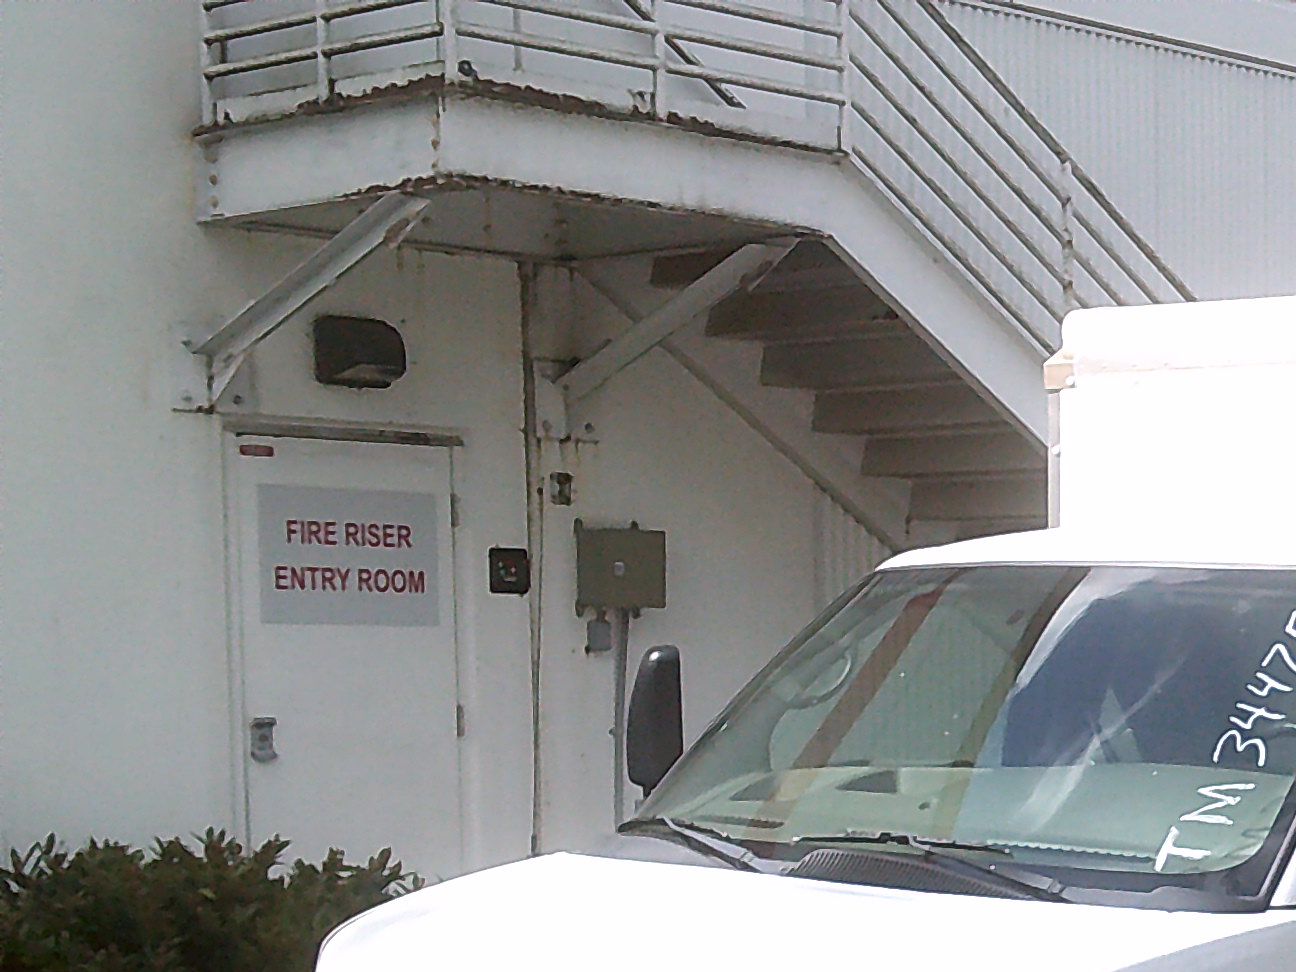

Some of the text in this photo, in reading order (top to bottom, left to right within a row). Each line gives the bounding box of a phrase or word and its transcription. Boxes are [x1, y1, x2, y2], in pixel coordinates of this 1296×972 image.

[286, 519, 413, 549] FIRE RISER
[274, 565, 426, 594] ENTRY ROOM
[1153, 782, 1257, 872] TM
